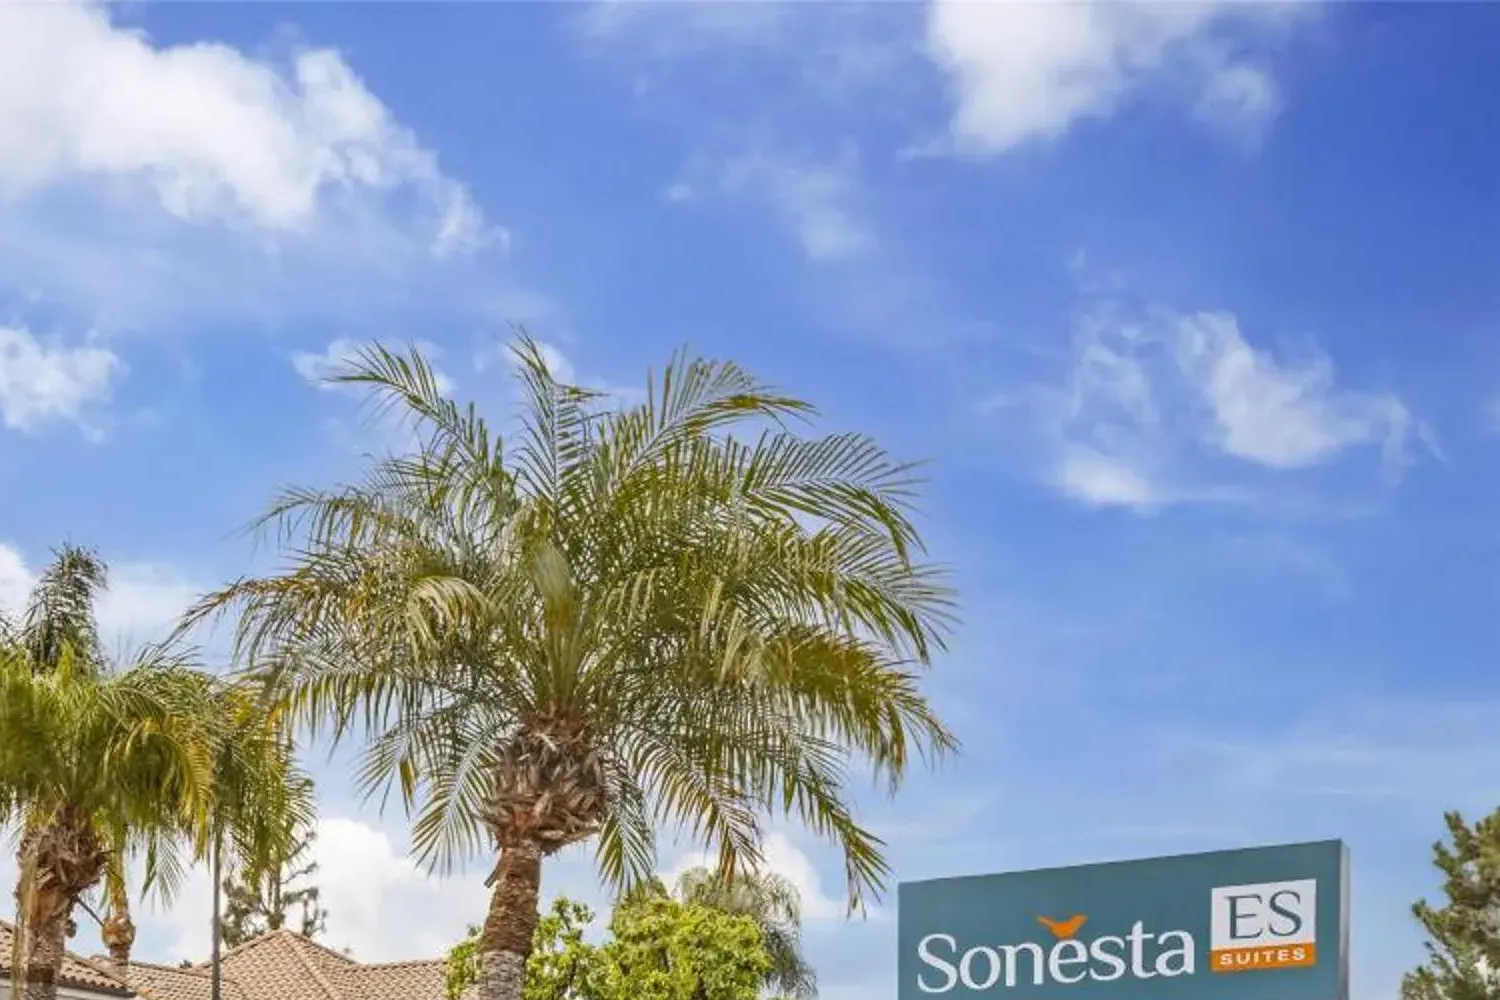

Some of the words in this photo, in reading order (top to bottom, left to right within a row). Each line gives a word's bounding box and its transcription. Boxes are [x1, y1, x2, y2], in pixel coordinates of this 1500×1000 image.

[1226, 889, 1302, 940] ES
[917, 920, 1195, 993] Sonesta
[1219, 948, 1306, 967] SUITES
